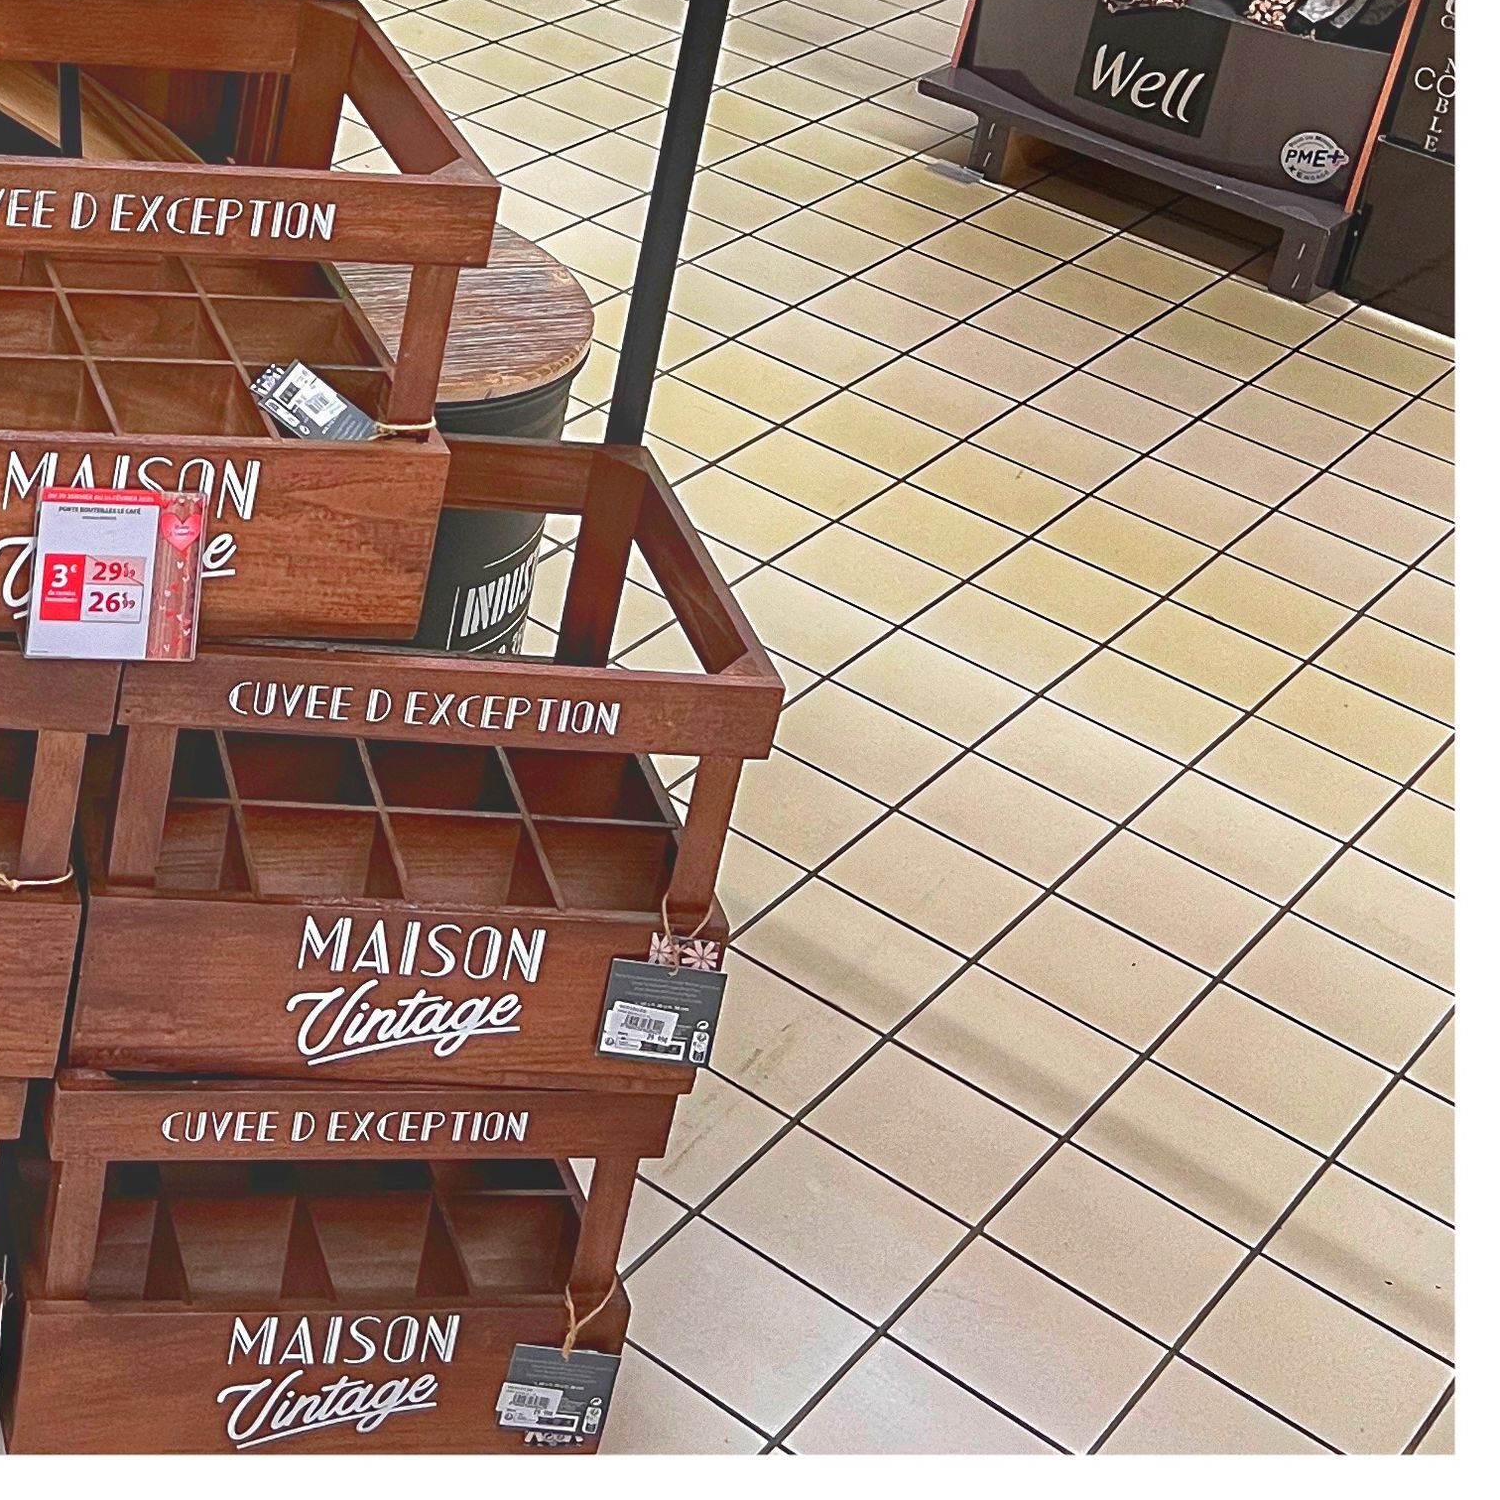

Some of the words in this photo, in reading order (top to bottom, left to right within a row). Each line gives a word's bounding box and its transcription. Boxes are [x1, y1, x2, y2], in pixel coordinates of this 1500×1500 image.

[1092, 43, 1205, 123] Well
[70, 191, 98, 230] D
[110, 192, 337, 242] EXCEPTION
[2, 450, 262, 523] MAISON
[227, 680, 354, 721] CUVEE
[365, 687, 393, 723] D
[404, 690, 621, 736] EXCEPTION
[297, 914, 547, 984] MAISON
[286, 979, 522, 1067] Vintage
[161, 1110, 280, 1143] CUVEE
[290, 1110, 316, 1143] D
[326, 1110, 530, 1143] EXCEPTION
[226, 1313, 461, 1366] MAISON
[216, 1369, 439, 1450] Vintage
